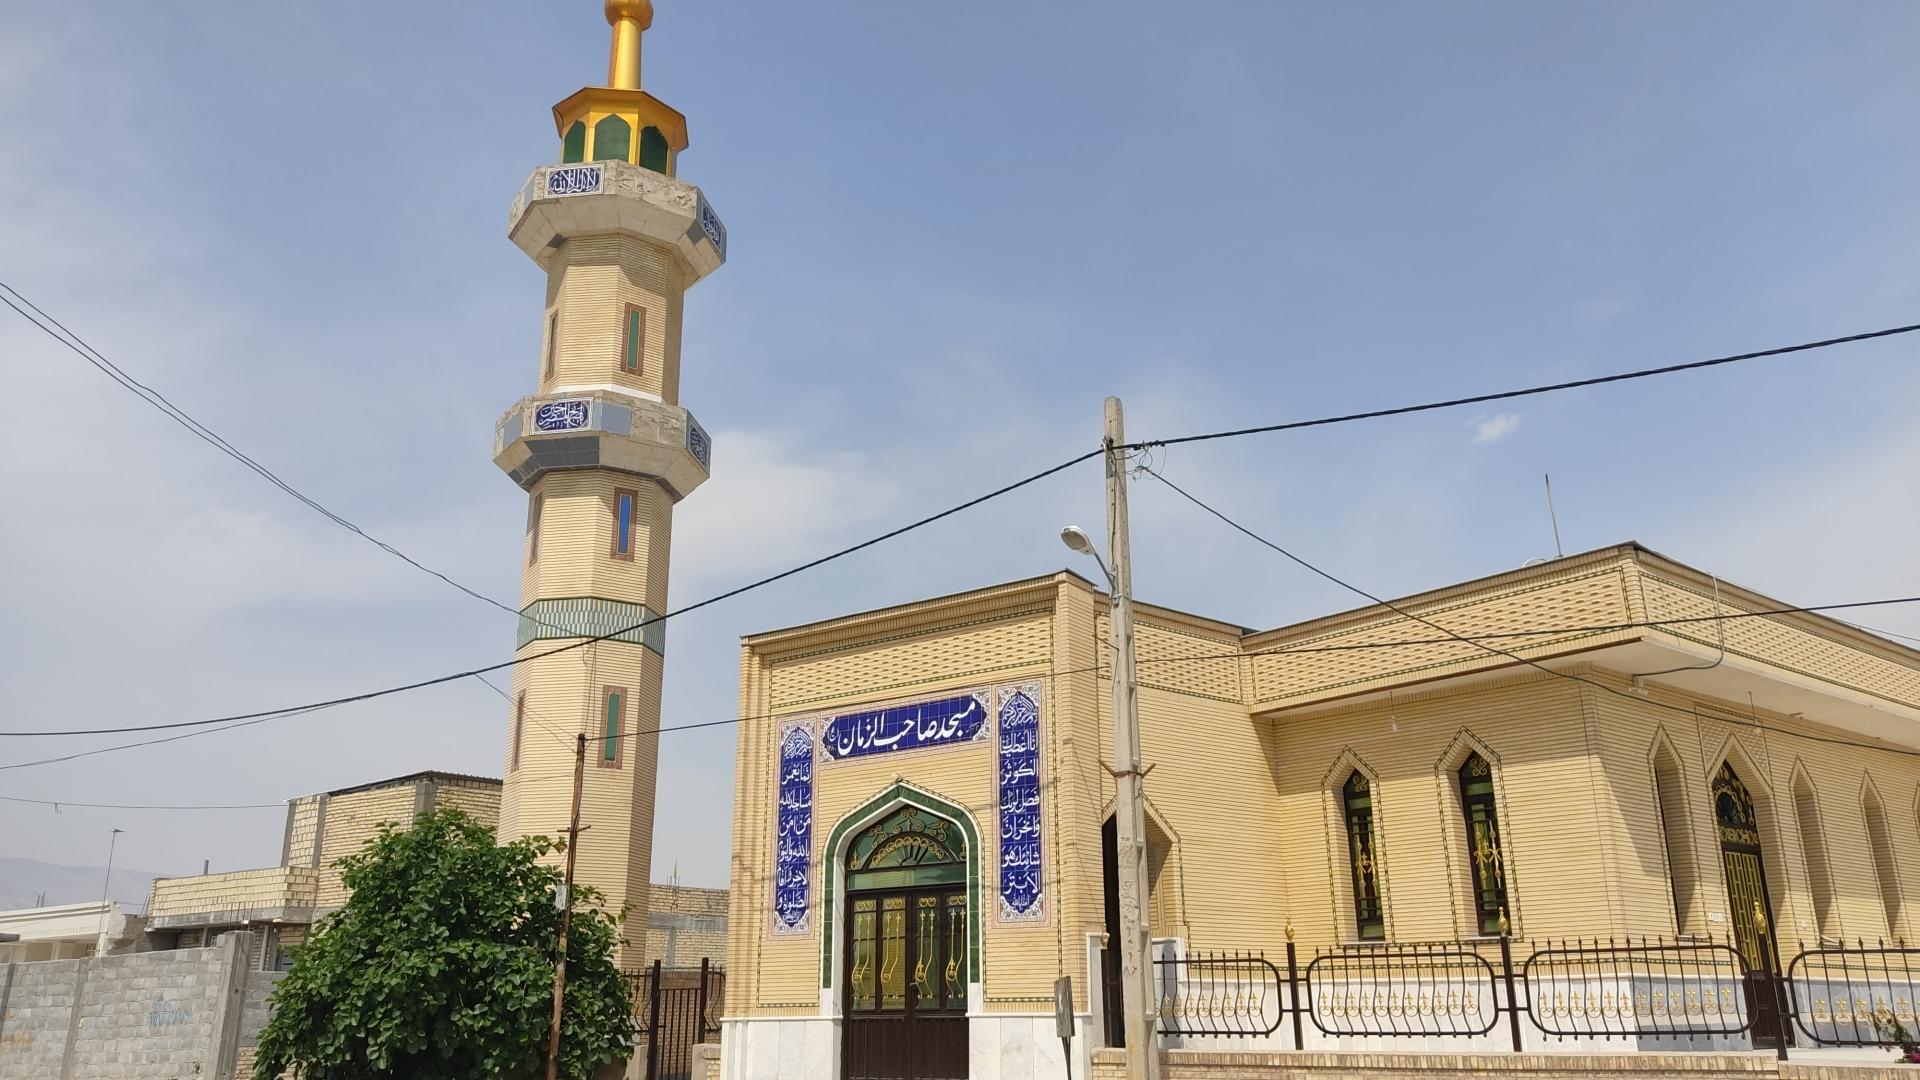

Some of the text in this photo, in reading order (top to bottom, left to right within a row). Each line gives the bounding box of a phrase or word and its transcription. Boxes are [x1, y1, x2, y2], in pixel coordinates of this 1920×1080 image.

[837, 701, 976, 756] مسجد صاحب الزمان
